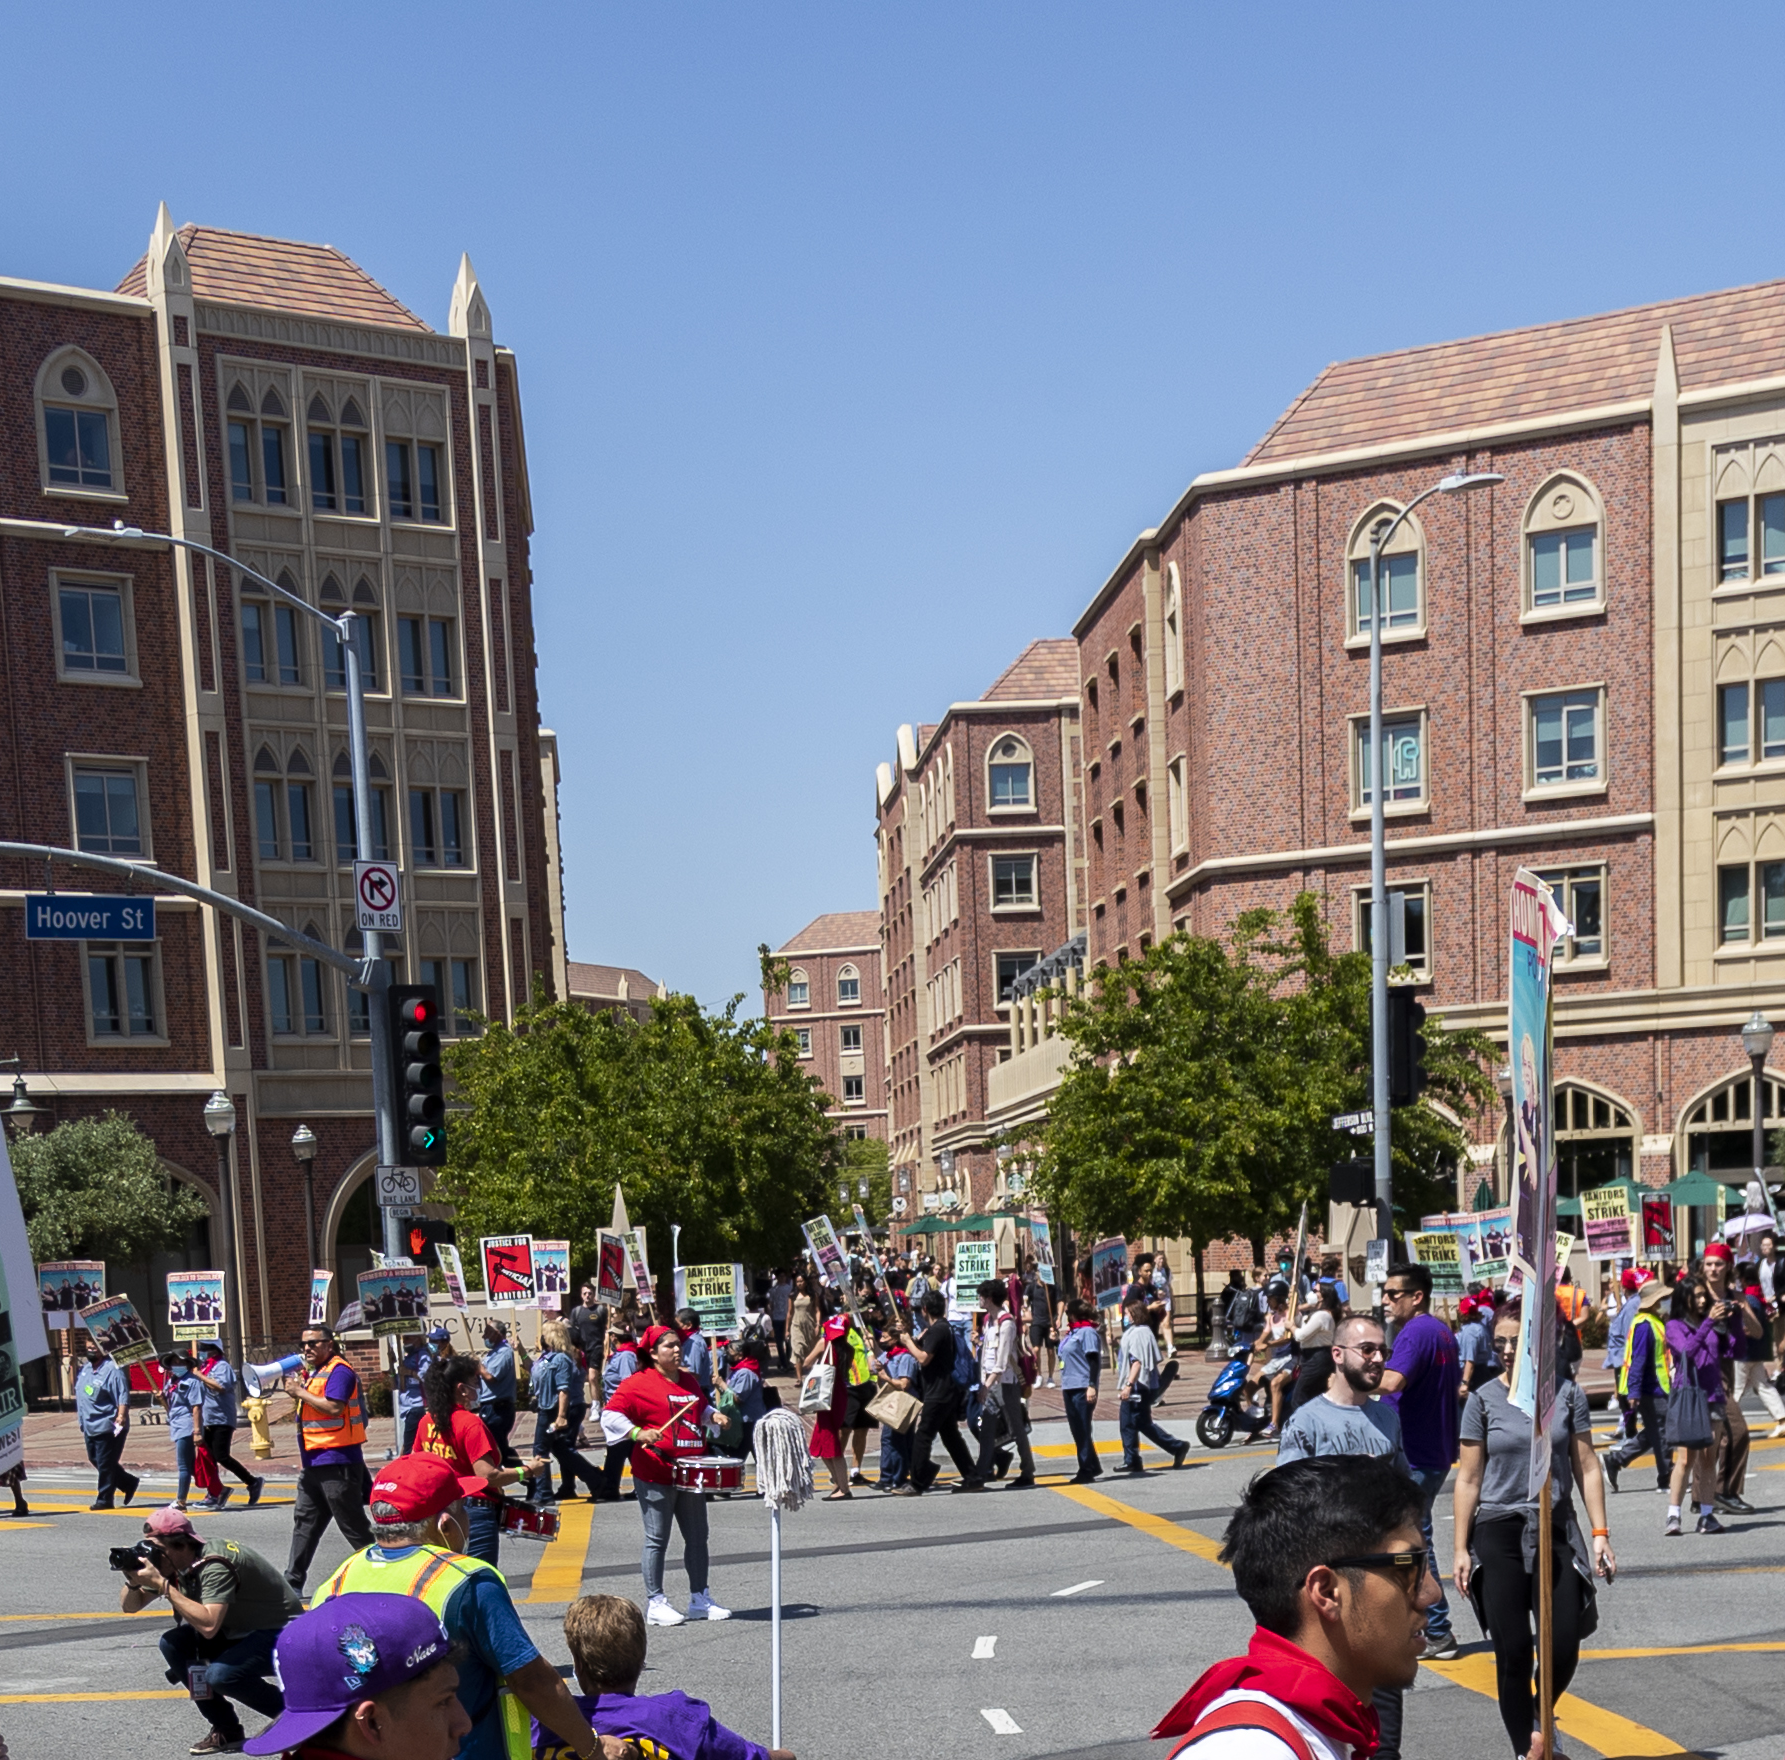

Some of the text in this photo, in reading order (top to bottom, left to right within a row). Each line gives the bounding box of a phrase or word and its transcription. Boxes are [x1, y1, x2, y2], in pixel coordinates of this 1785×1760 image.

[37, 906, 144, 929] Hoover St
[361, 913, 398, 927] ON RED
[400, 1195, 416, 1203] LANE
[1588, 1205, 1626, 1220] STRIKE
[487, 1237, 527, 1249] JUSTICE FOR
[958, 1243, 992, 1254] JANITORS
[1418, 1249, 1457, 1262] STRIKE
[687, 1265, 732, 1279] JANITORS
[958, 1259, 990, 1273] STRIKE
[493, 1290, 532, 1300] JANITORS
[690, 1282, 731, 1296] STRIKE
